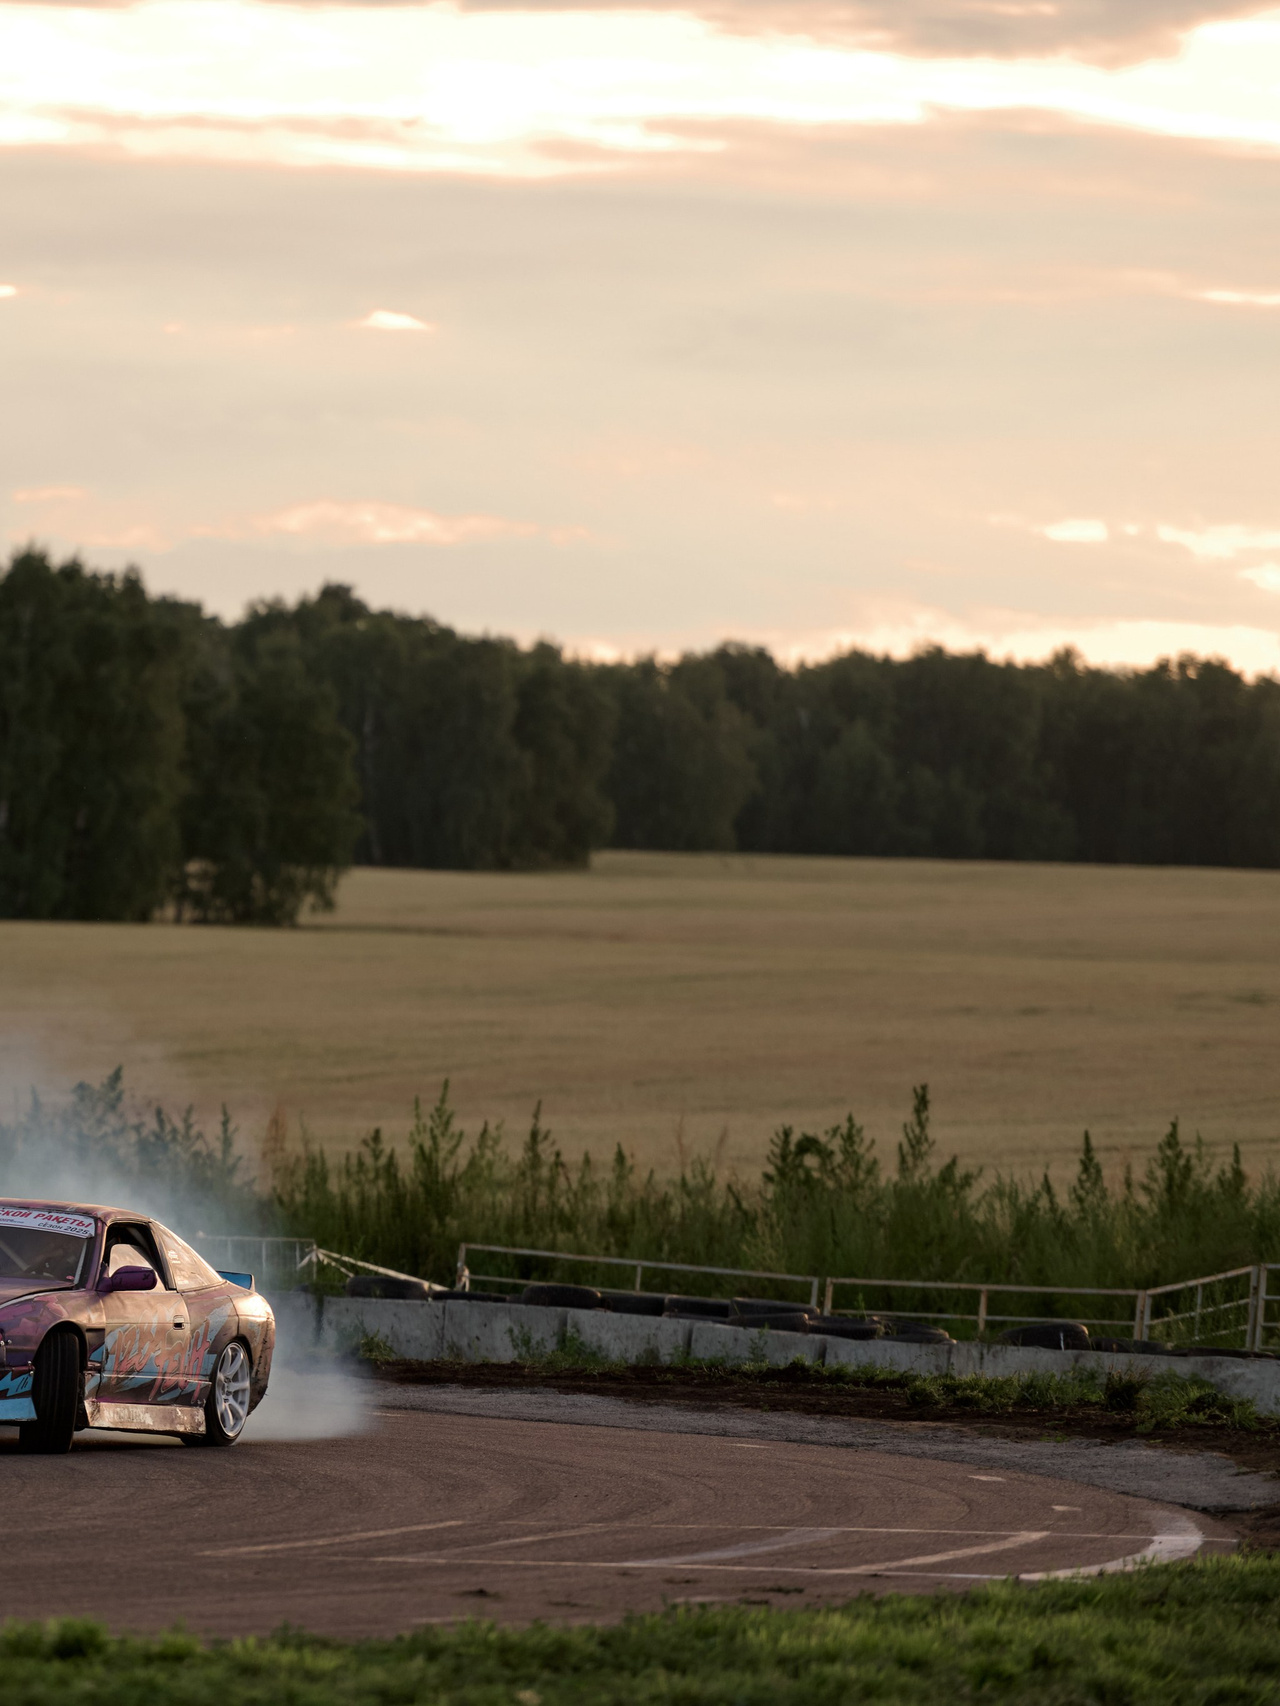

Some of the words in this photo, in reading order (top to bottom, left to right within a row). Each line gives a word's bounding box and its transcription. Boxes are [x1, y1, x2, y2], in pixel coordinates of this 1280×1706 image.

[33, 1213, 93, 1228] РАКЕТЫ
[37, 1222, 63, 1230] СЕЗОН
[64, 1225, 89, 1235] 2025
